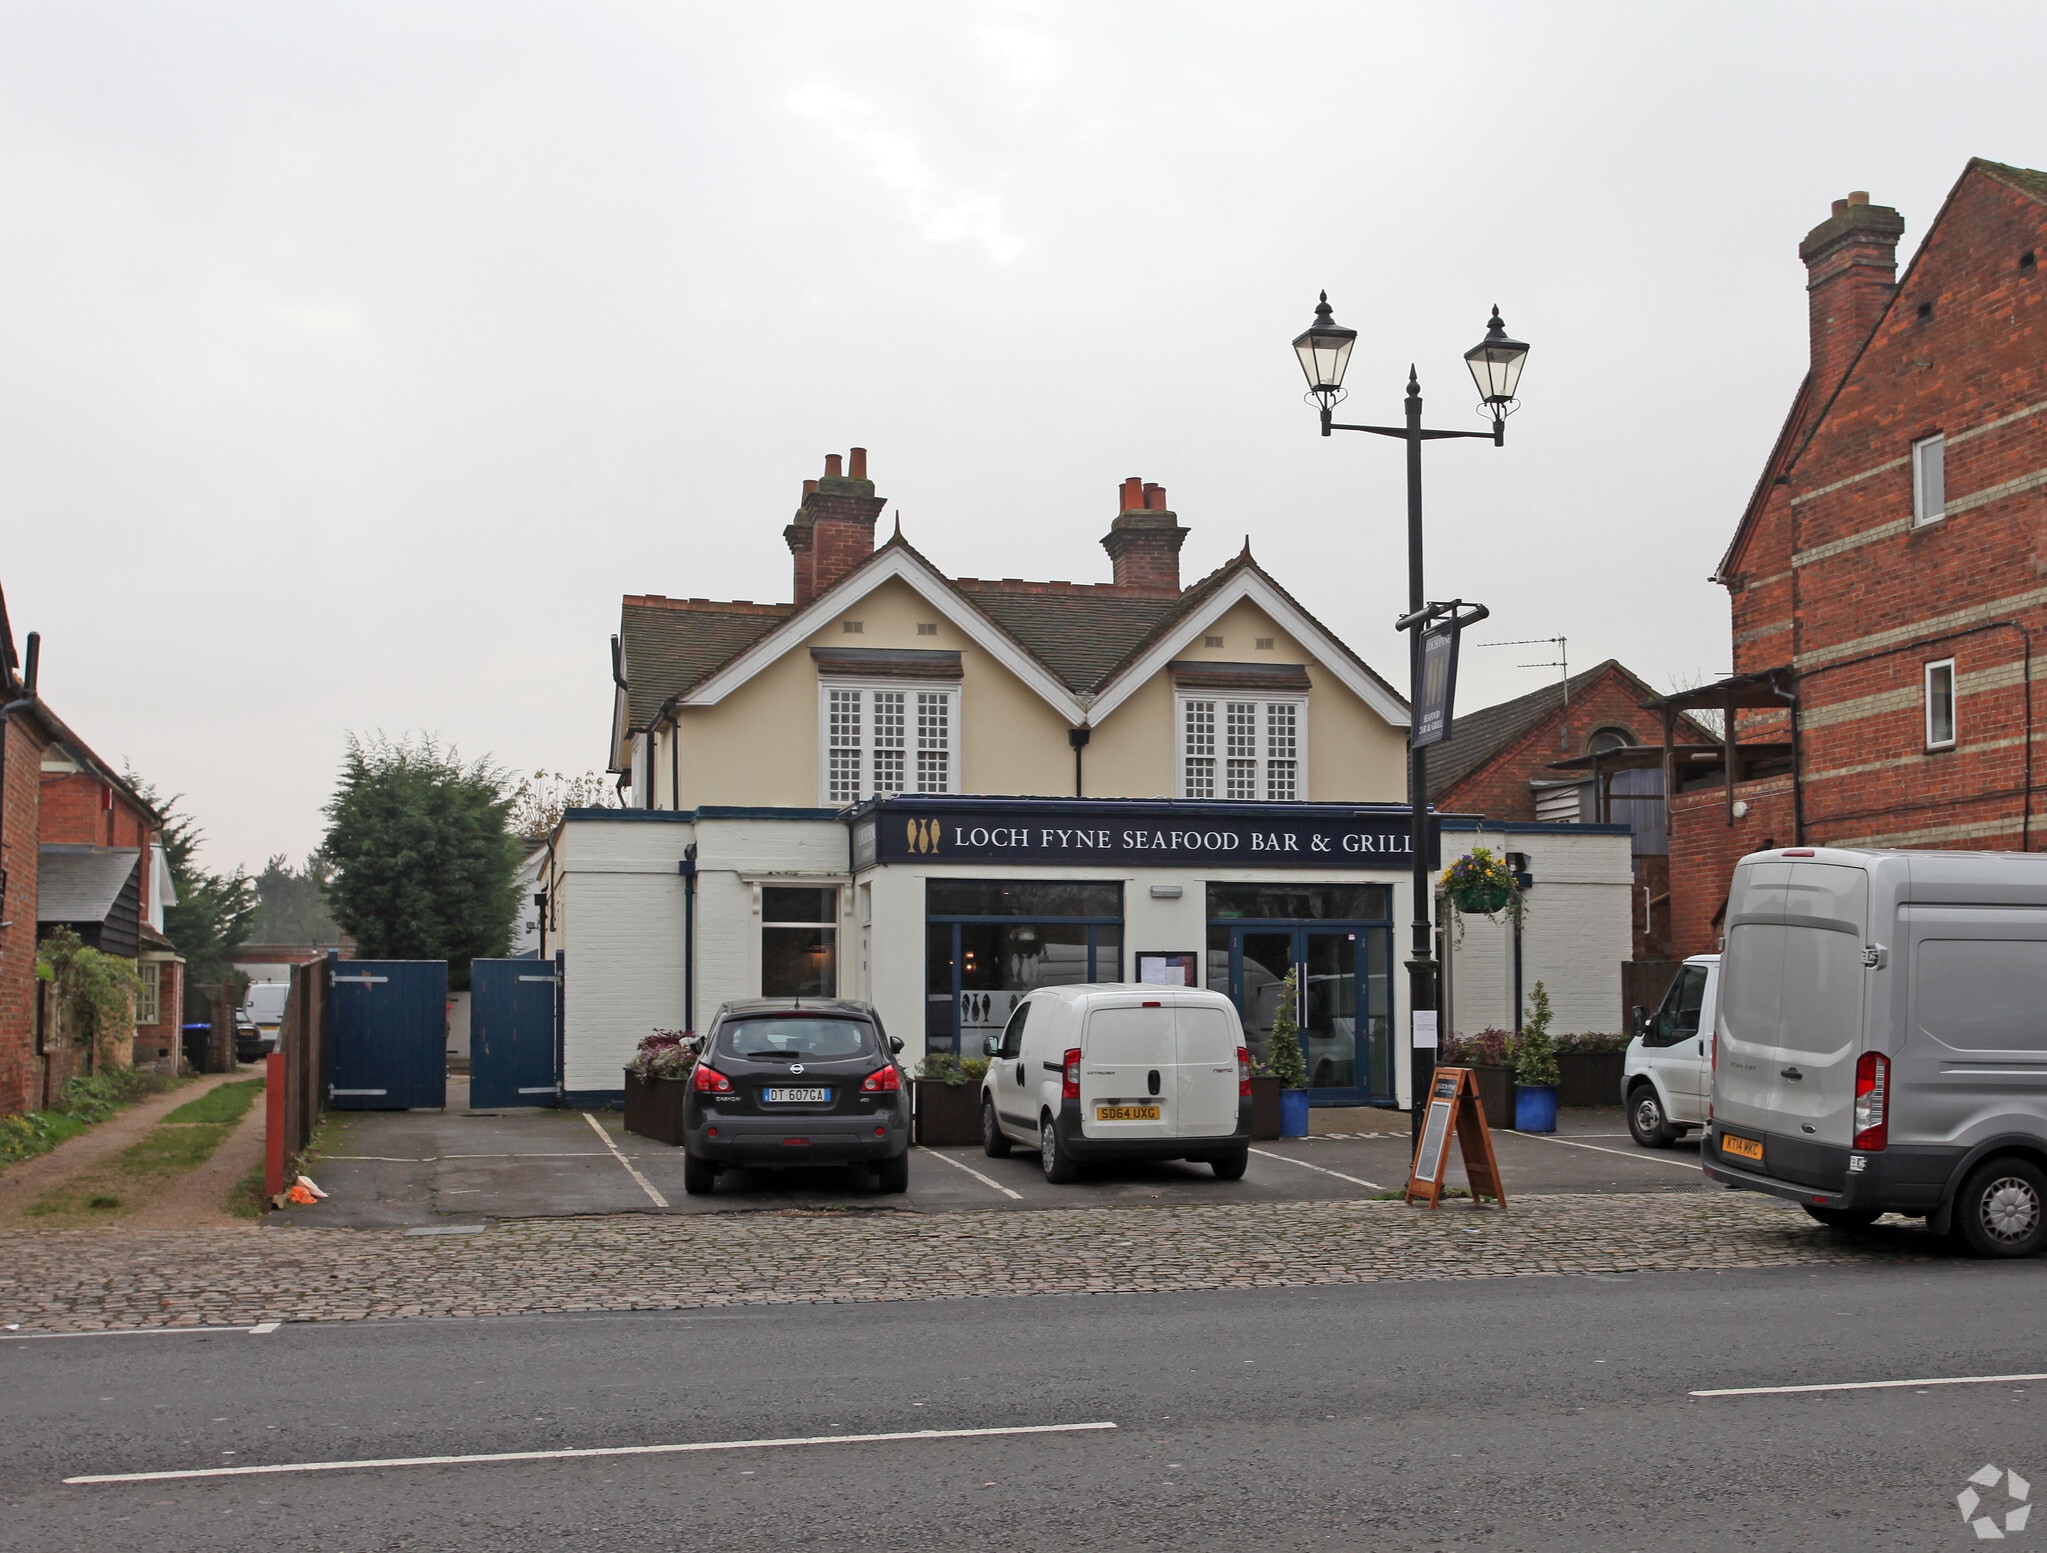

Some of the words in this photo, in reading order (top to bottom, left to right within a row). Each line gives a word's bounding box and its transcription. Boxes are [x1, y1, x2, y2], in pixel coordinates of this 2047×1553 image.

[955, 827, 1030, 847] LOCH
[1040, 829, 1112, 848] FYNE
[1122, 830, 1239, 850] SEAFOOD
[1250, 832, 1300, 851] BAR
[1310, 833, 1331, 852] &
[1342, 834, 1414, 853] GRILL
[770, 1089, 784, 1101] DT
[789, 1089, 824, 1101] 607GA
[1101, 1108, 1131, 1119] SD64
[1133, 1108, 1156, 1119] UXG
